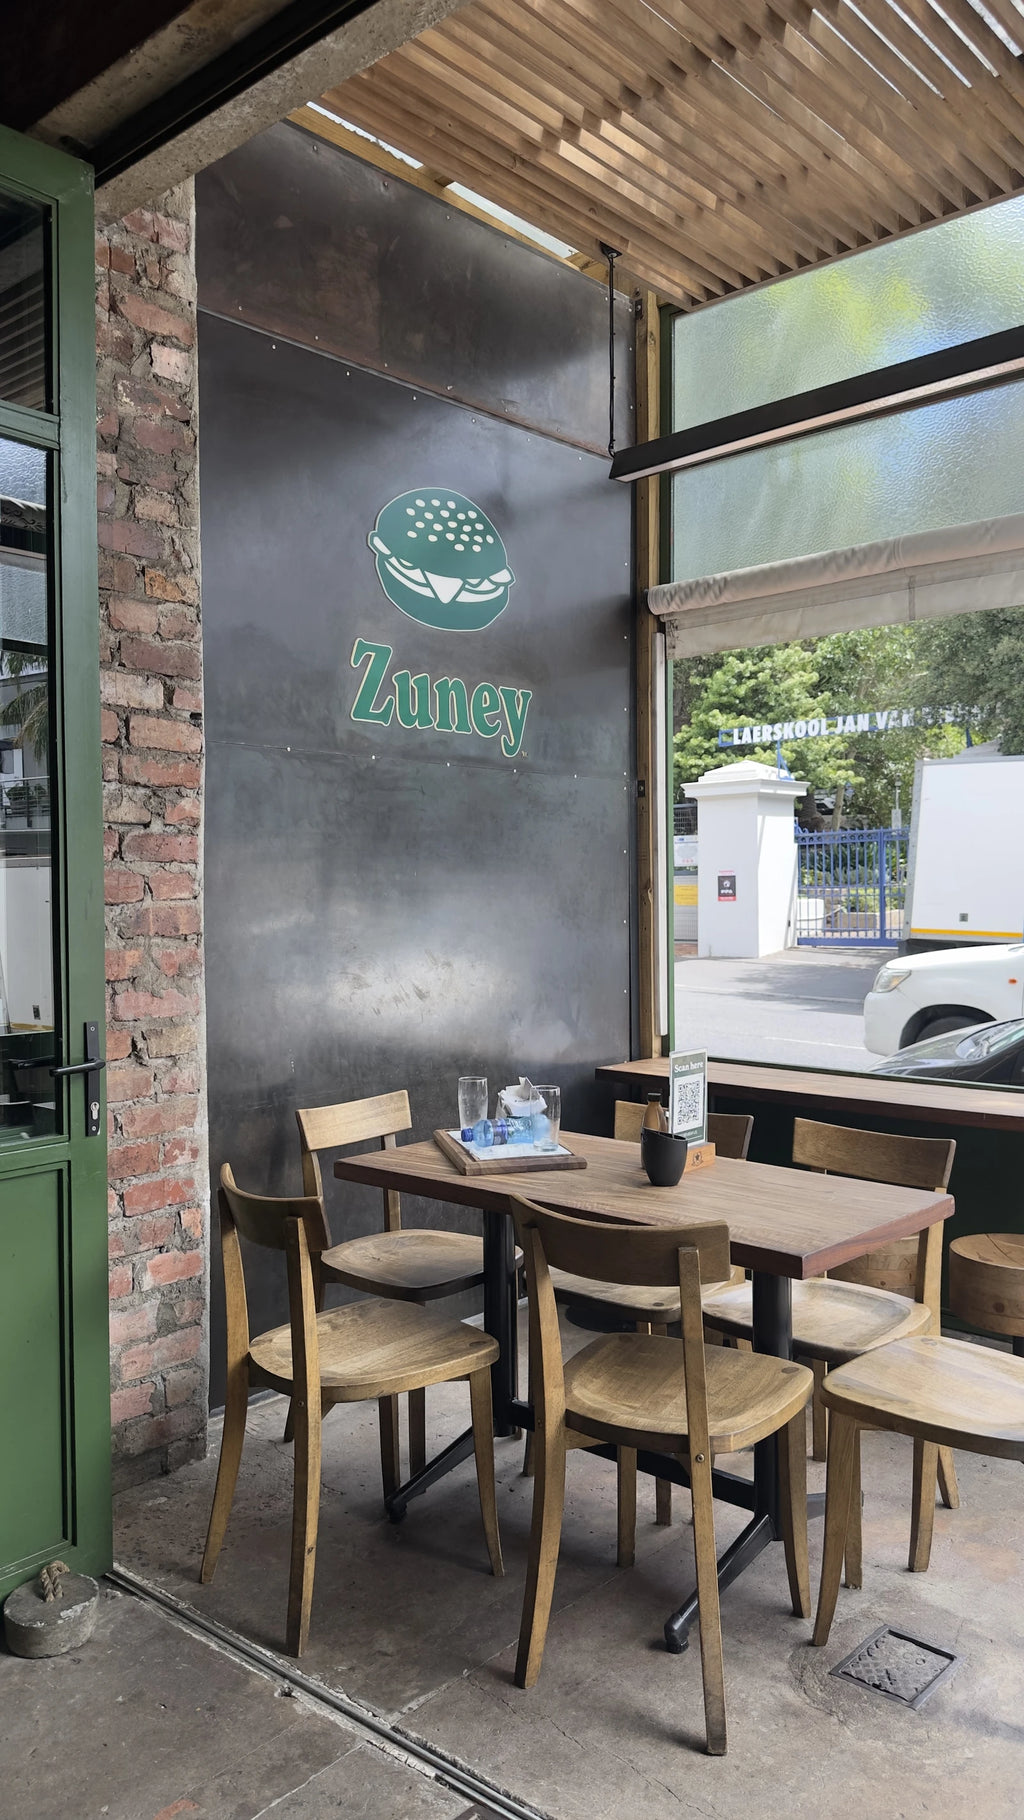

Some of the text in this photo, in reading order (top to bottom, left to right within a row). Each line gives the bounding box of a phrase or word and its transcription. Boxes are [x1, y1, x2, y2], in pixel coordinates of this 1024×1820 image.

[350, 637, 532, 758] Zuney
[733, 718, 829, 745] LAERSKOOL
[835, 713, 870, 734] JAN
[674, 1061, 704, 1073] Scan here
